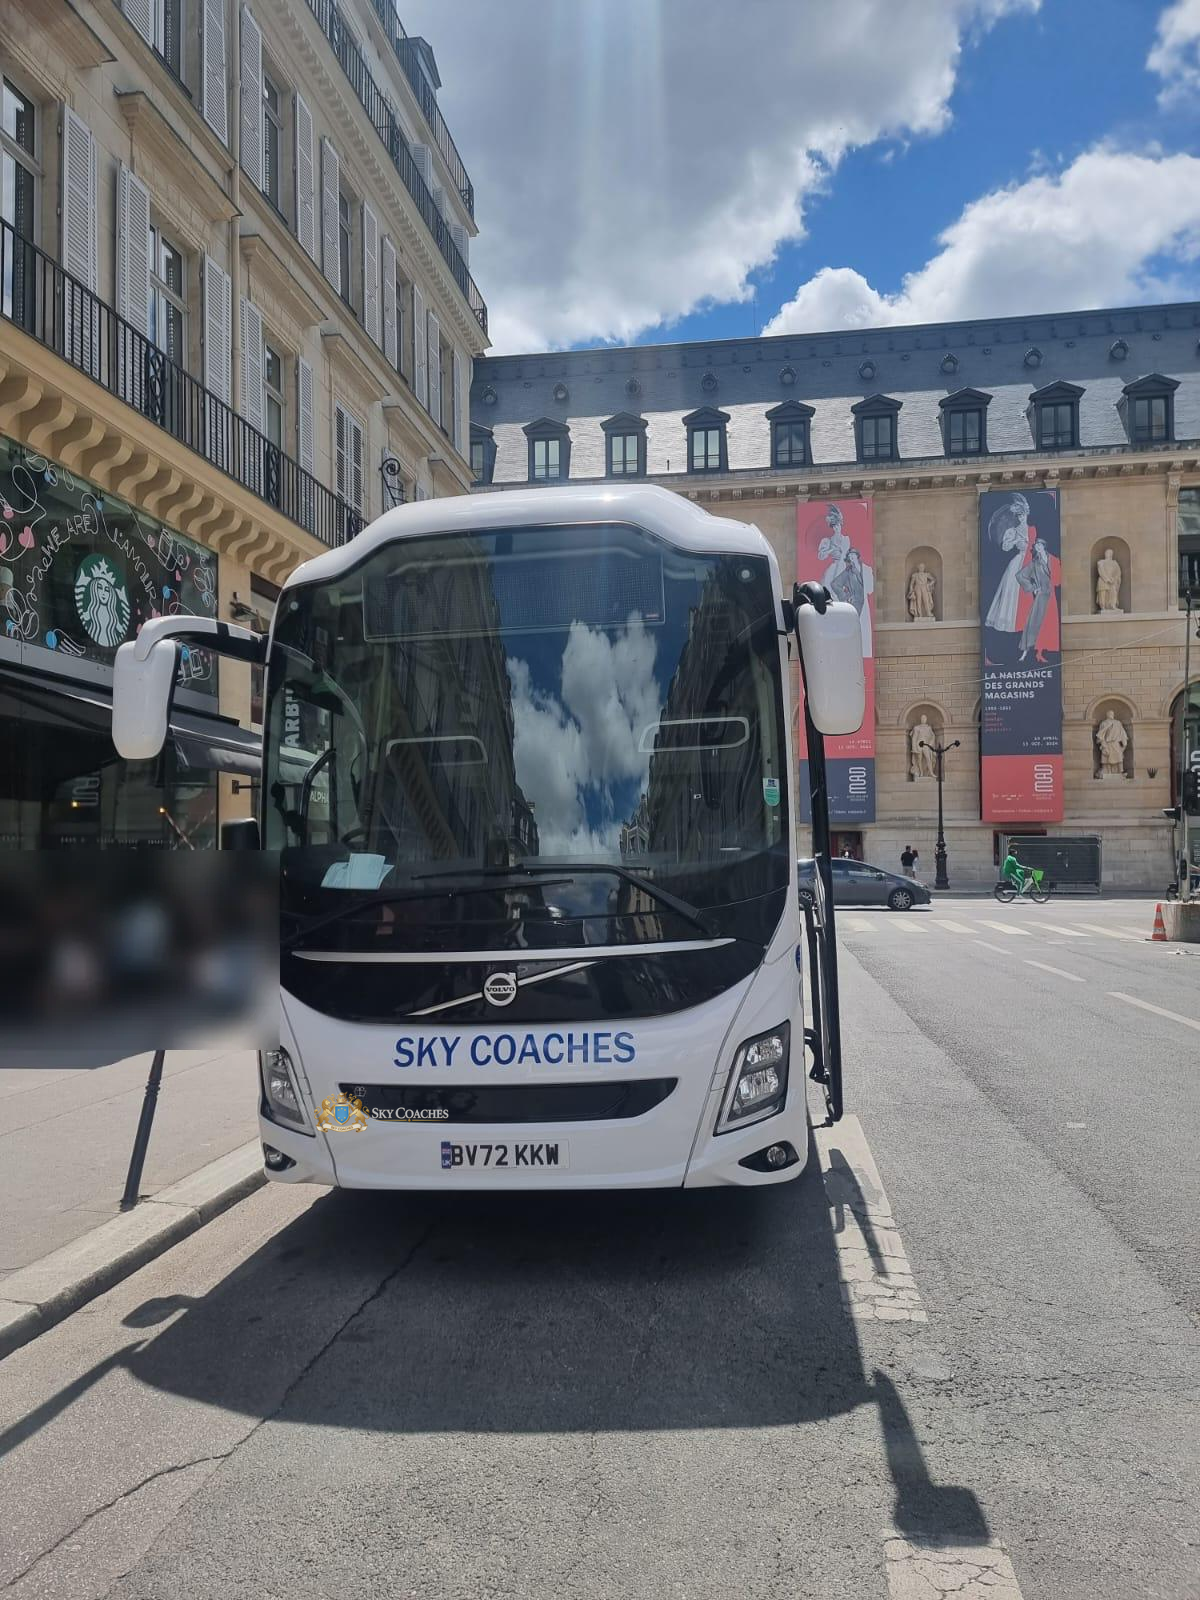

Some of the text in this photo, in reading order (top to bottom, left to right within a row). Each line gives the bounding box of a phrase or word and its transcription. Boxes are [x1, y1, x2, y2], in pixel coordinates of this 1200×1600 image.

[985, 671, 1053, 680] LA NAISSANCE
[985, 680, 1045, 690] DES GRANDS
[985, 691, 1035, 700] MAGASINS
[393, 1031, 636, 1068] SKY COACHES
[451, 1144, 559, 1167] BV72 KKW
